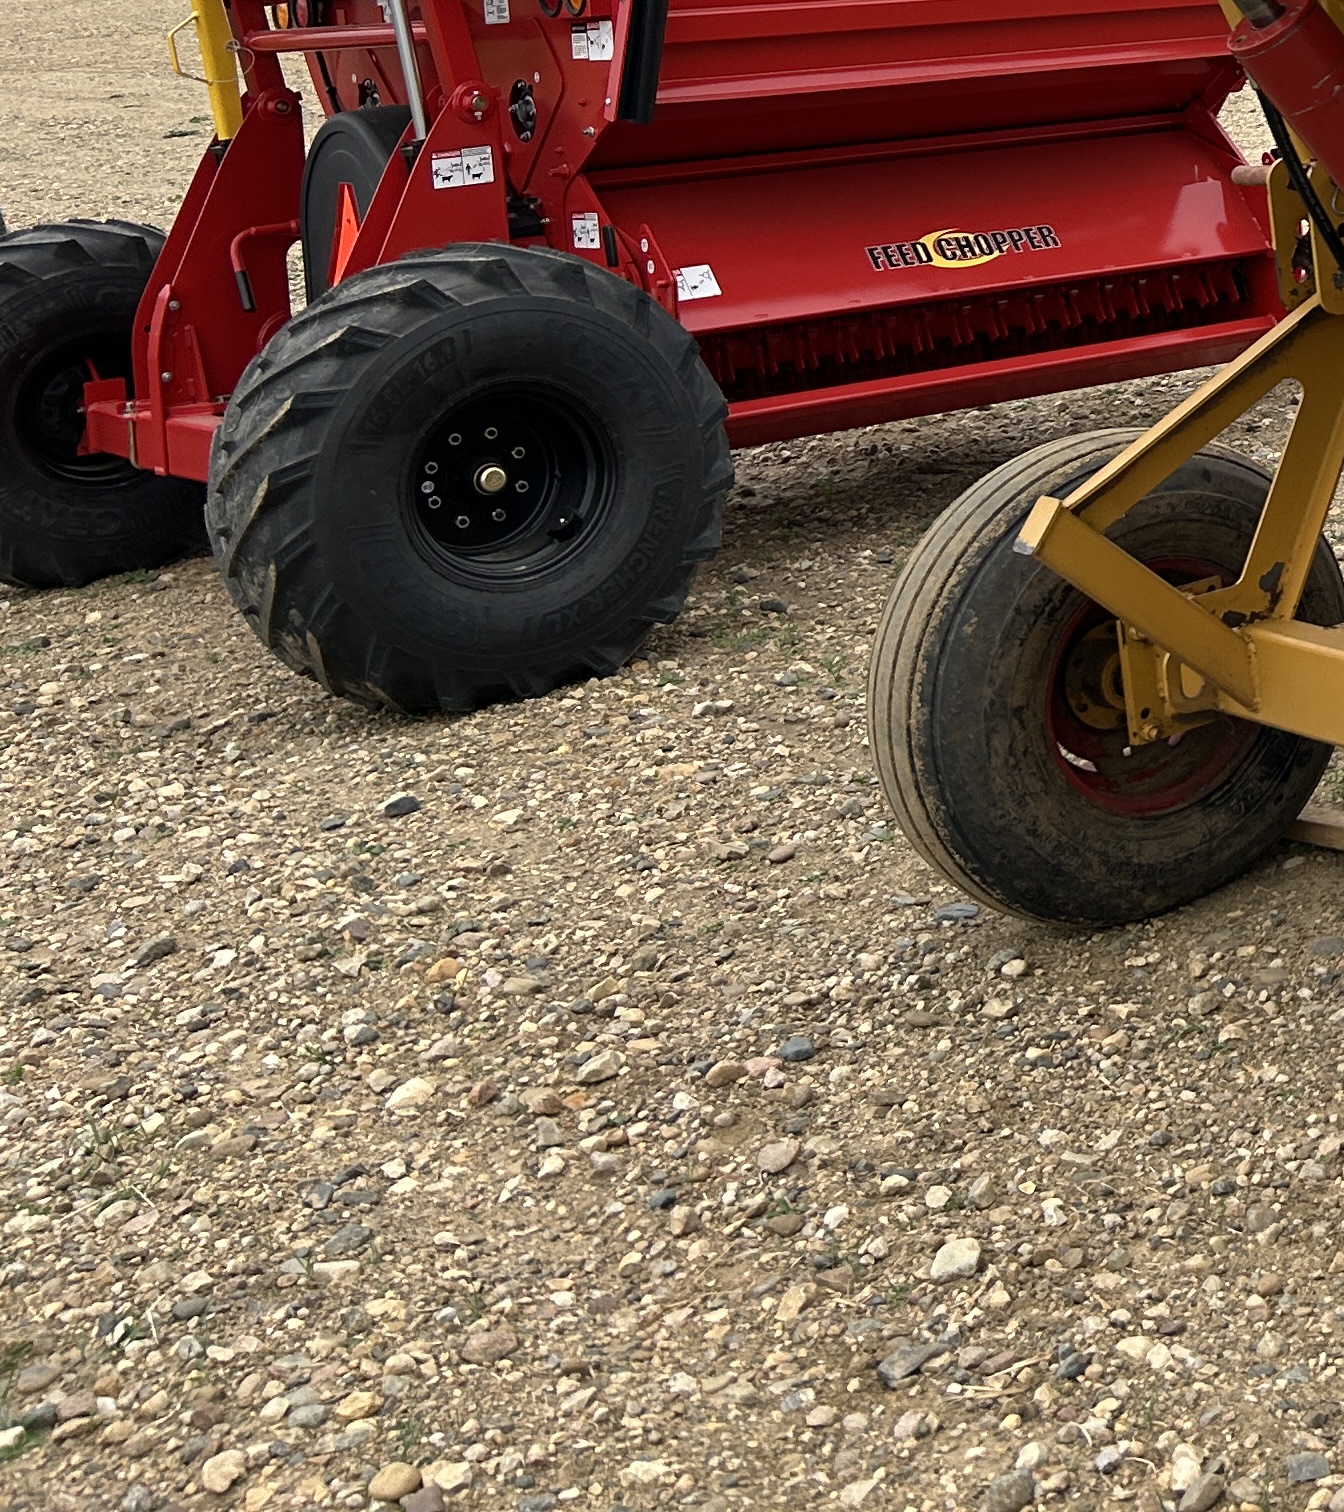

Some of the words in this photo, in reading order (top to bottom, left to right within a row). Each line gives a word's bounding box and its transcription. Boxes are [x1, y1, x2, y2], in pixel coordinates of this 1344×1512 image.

[864, 241, 934, 271] FEED
[935, 224, 1061, 262] CHOPPER
[587, 488, 682, 614] TRENCHER
